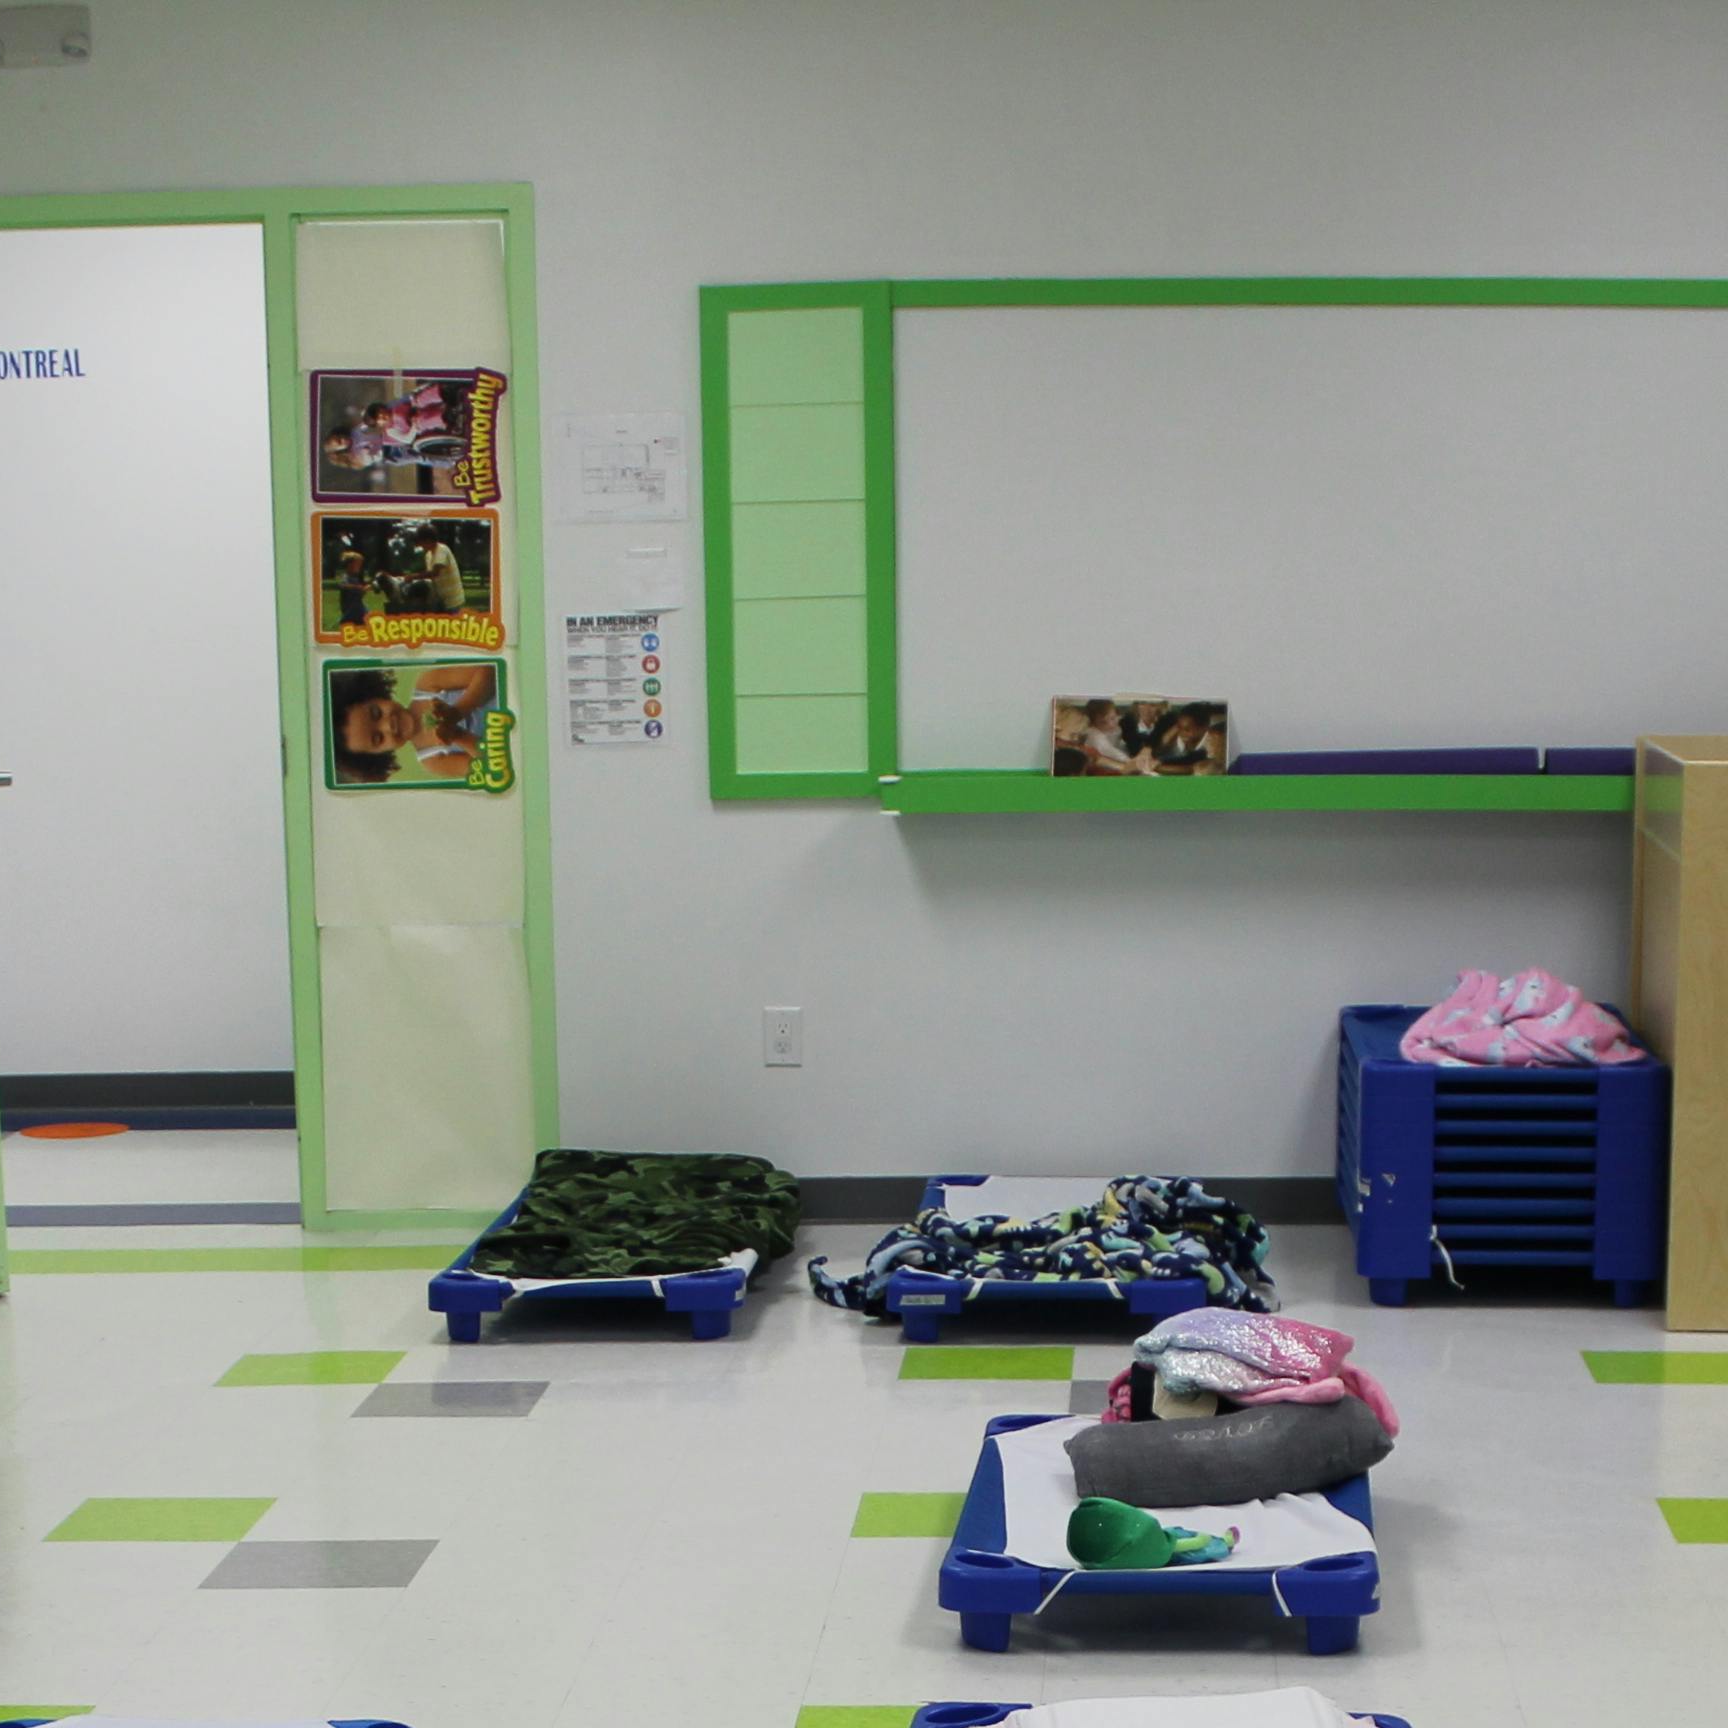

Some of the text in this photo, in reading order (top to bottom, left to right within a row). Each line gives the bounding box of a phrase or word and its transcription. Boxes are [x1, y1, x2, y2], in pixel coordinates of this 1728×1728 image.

[470, 372, 503, 504] Trustworthy
[454, 460, 470, 488] Be
[343, 613, 500, 646] Be Responsible
[597, 615, 658, 626] EMERGENCY
[484, 712, 513, 788] Caring
[469, 761, 485, 788] Be
